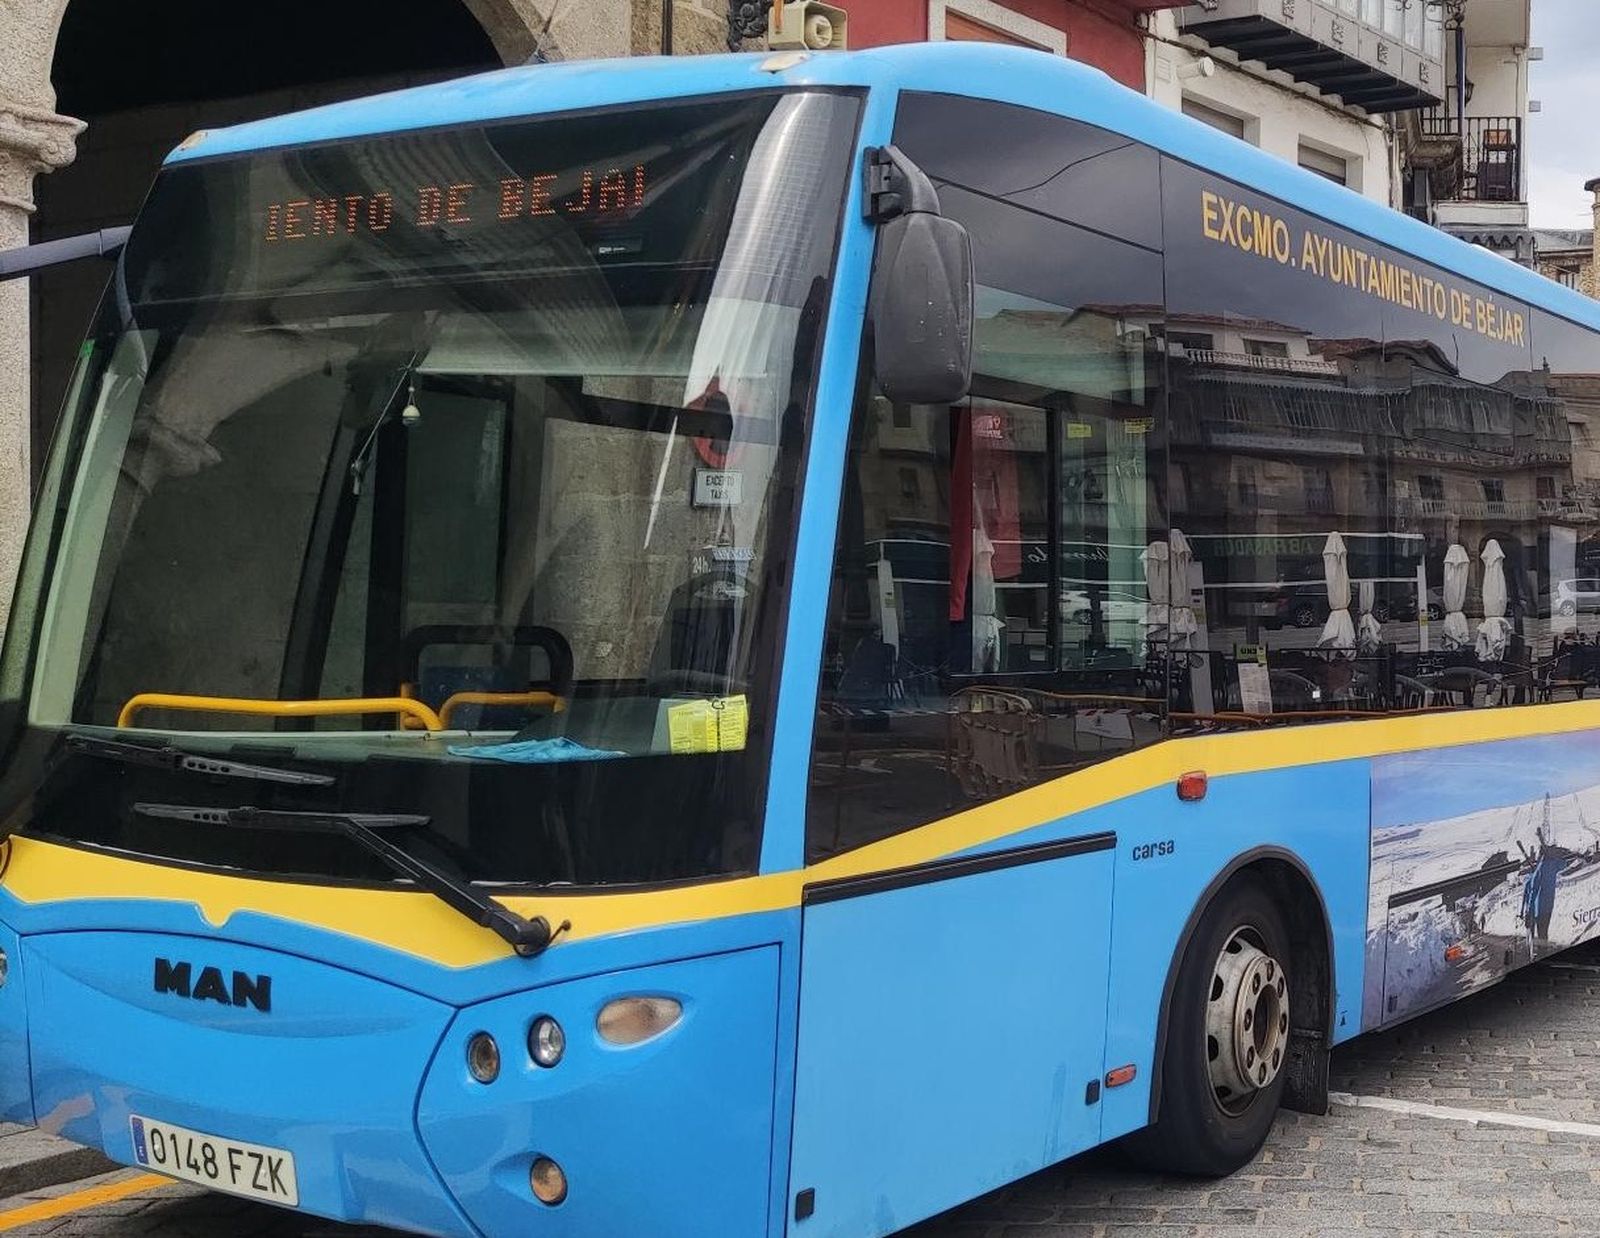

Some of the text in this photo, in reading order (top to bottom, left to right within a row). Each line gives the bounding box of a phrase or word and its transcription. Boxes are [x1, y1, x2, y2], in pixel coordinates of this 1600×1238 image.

[416, 183, 474, 226] DE
[498, 164, 645, 218] BEJA
[1202, 190, 1525, 347] EXCMO. AYUNTAMIENTO DE BÉJAR
[1132, 839, 1175, 861] carsa
[154, 957, 272, 1013] MAN
[150, 1127, 289, 1196] 0148 FZK
